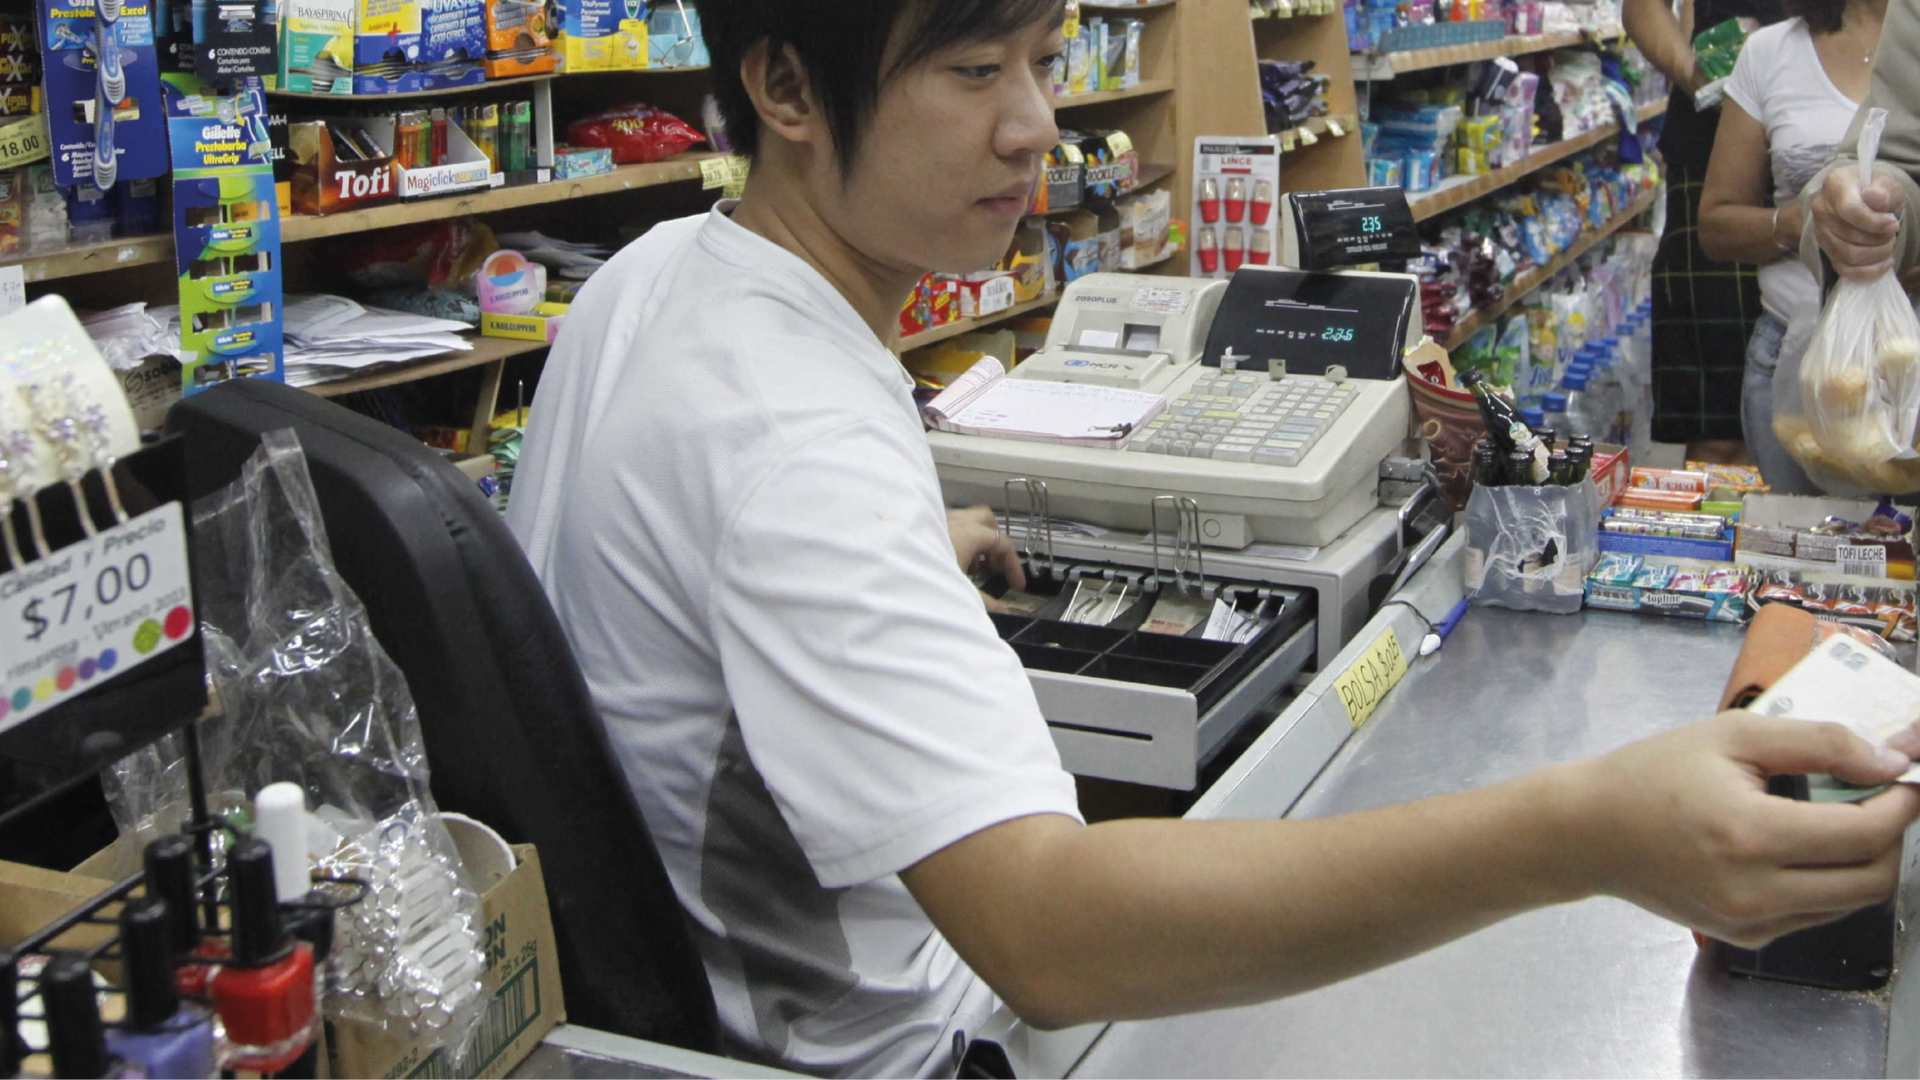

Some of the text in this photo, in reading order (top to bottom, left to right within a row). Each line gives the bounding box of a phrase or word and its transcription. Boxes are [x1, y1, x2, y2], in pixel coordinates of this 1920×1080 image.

[120, 6, 147, 16] Excel
[298, 7, 347, 21] BAYASPIRINA
[208, 49, 216, 60] 6
[612, 117, 645, 132] 400
[202, 125, 241, 140] Gillette
[195, 141, 247, 153] Prestobarba
[61, 152, 70, 162] 6
[203, 152, 240, 165] UltraGrip
[1221, 156, 1253, 165] LINCE
[335, 165, 391, 199] Tofi
[407, 169, 456, 192] Magiclick
[1075, 295, 1118, 305] 2050PLUS
[103, 518, 166, 555] Precio
[1838, 546, 1885, 561] TOFI LECHE
[1341, 657, 1384, 721] BOLSA
